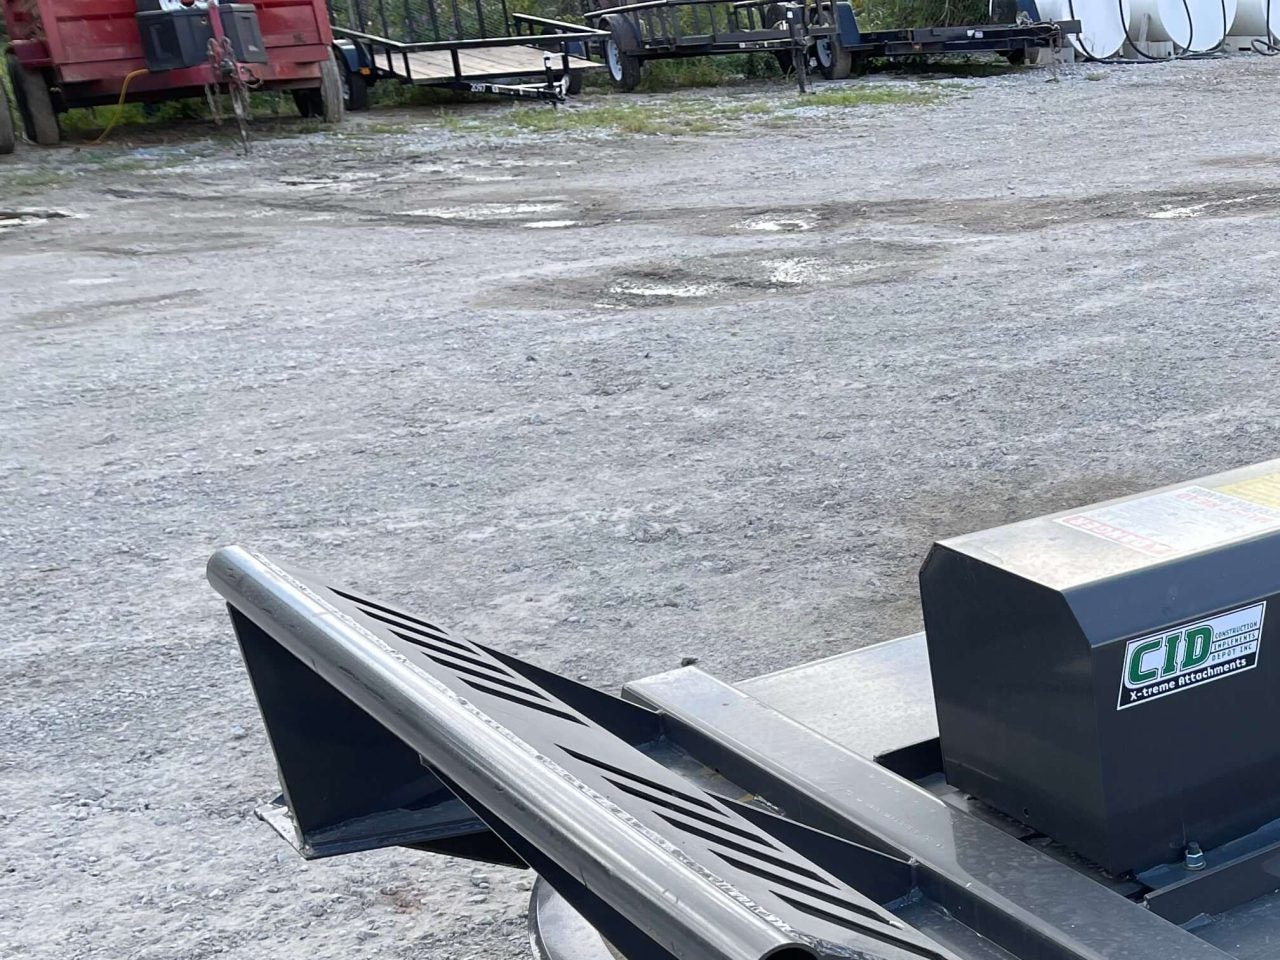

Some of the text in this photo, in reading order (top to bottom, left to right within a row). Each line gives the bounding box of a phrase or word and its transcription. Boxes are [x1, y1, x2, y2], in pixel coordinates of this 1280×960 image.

[1214, 621, 1258, 640] CONSTRUCTION
[1213, 632, 1257, 651] IMPLEMENTS
[1128, 624, 1214, 685] CID
[1211, 643, 1253, 662] DEPOT INC
[1129, 657, 1248, 702] X-treme Attachments
